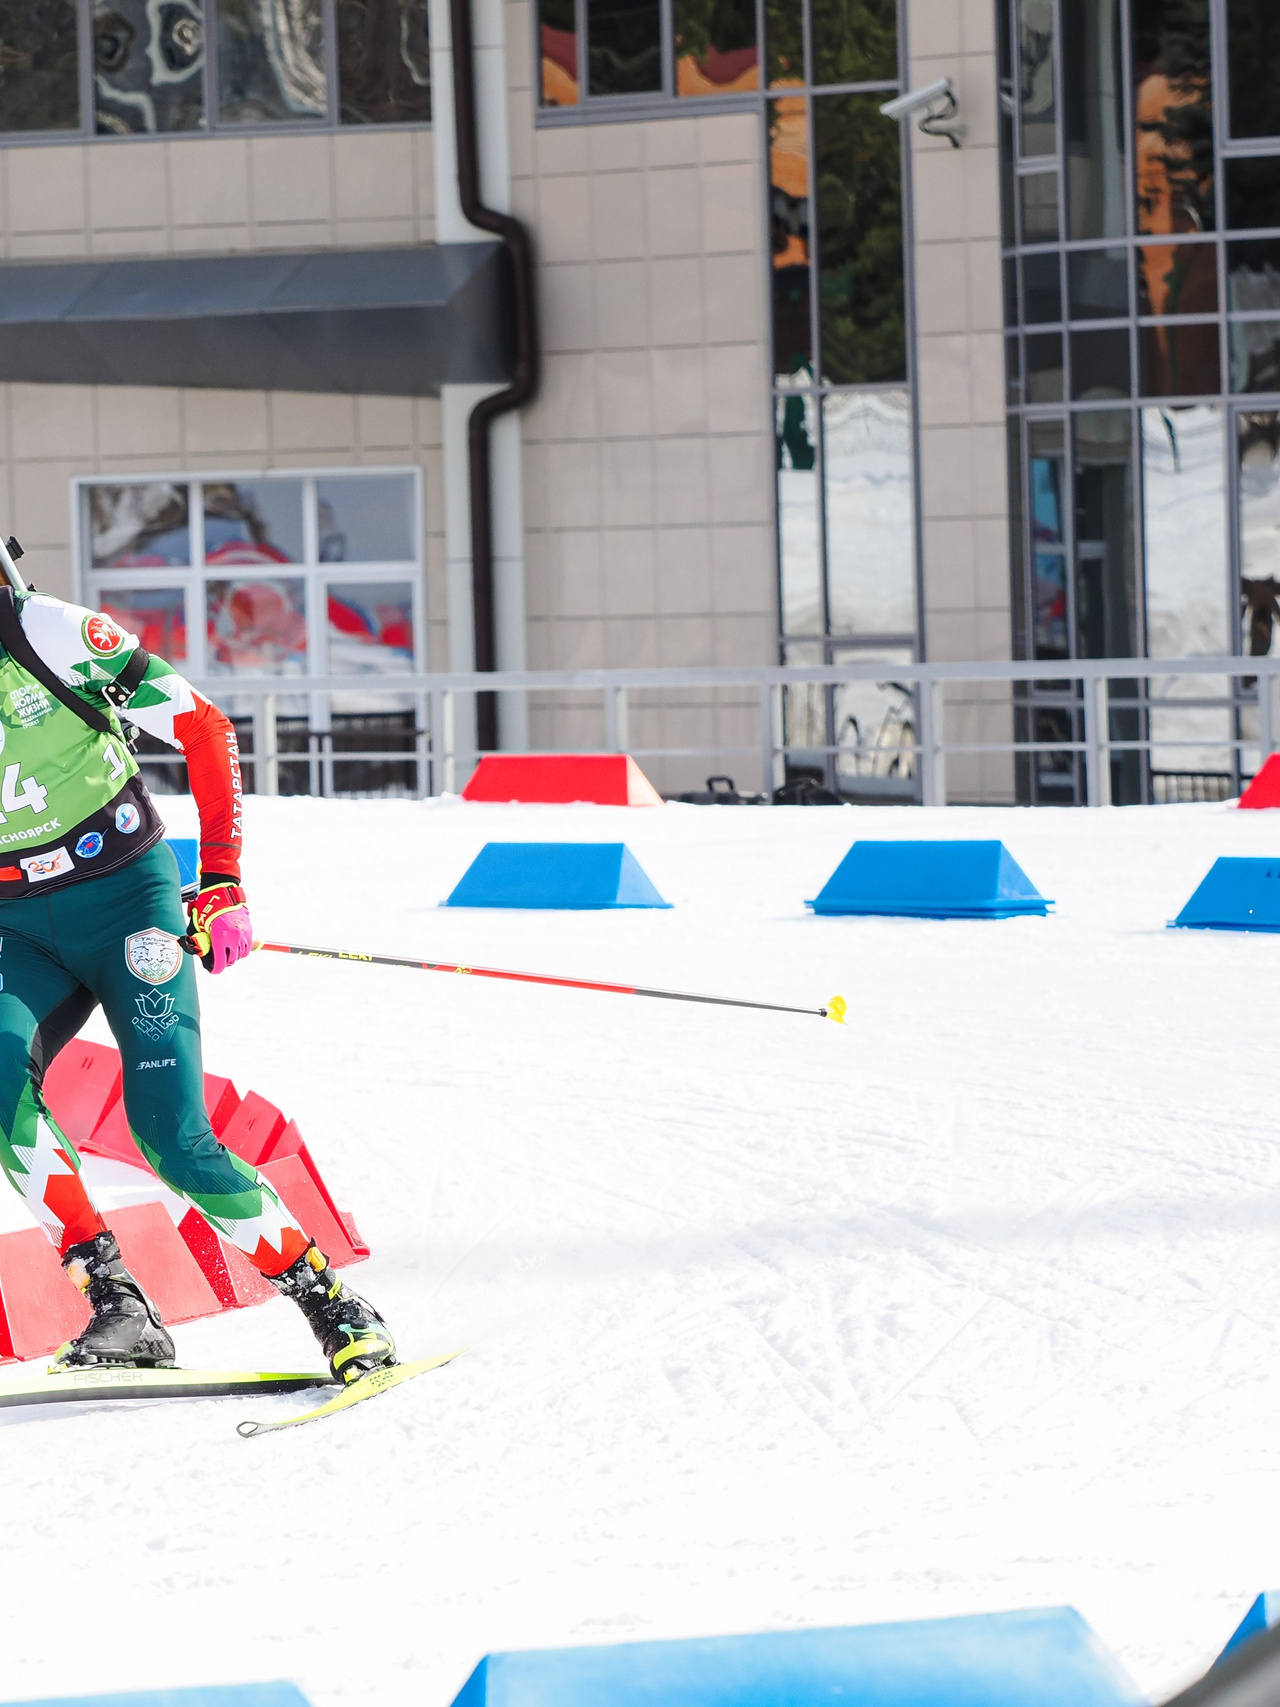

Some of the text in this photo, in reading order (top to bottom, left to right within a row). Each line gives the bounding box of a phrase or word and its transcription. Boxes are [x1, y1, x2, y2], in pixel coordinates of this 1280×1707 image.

[13, 690, 46, 709] НОРМА
[17, 698, 50, 719] ЖИЗНИ
[225, 731, 243, 839] ТАТАРСТАН
[198, 894, 221, 930] LEKI
[136, 1058, 177, 1070] FANLIFE
[73, 1371, 144, 1385] FISCHER
